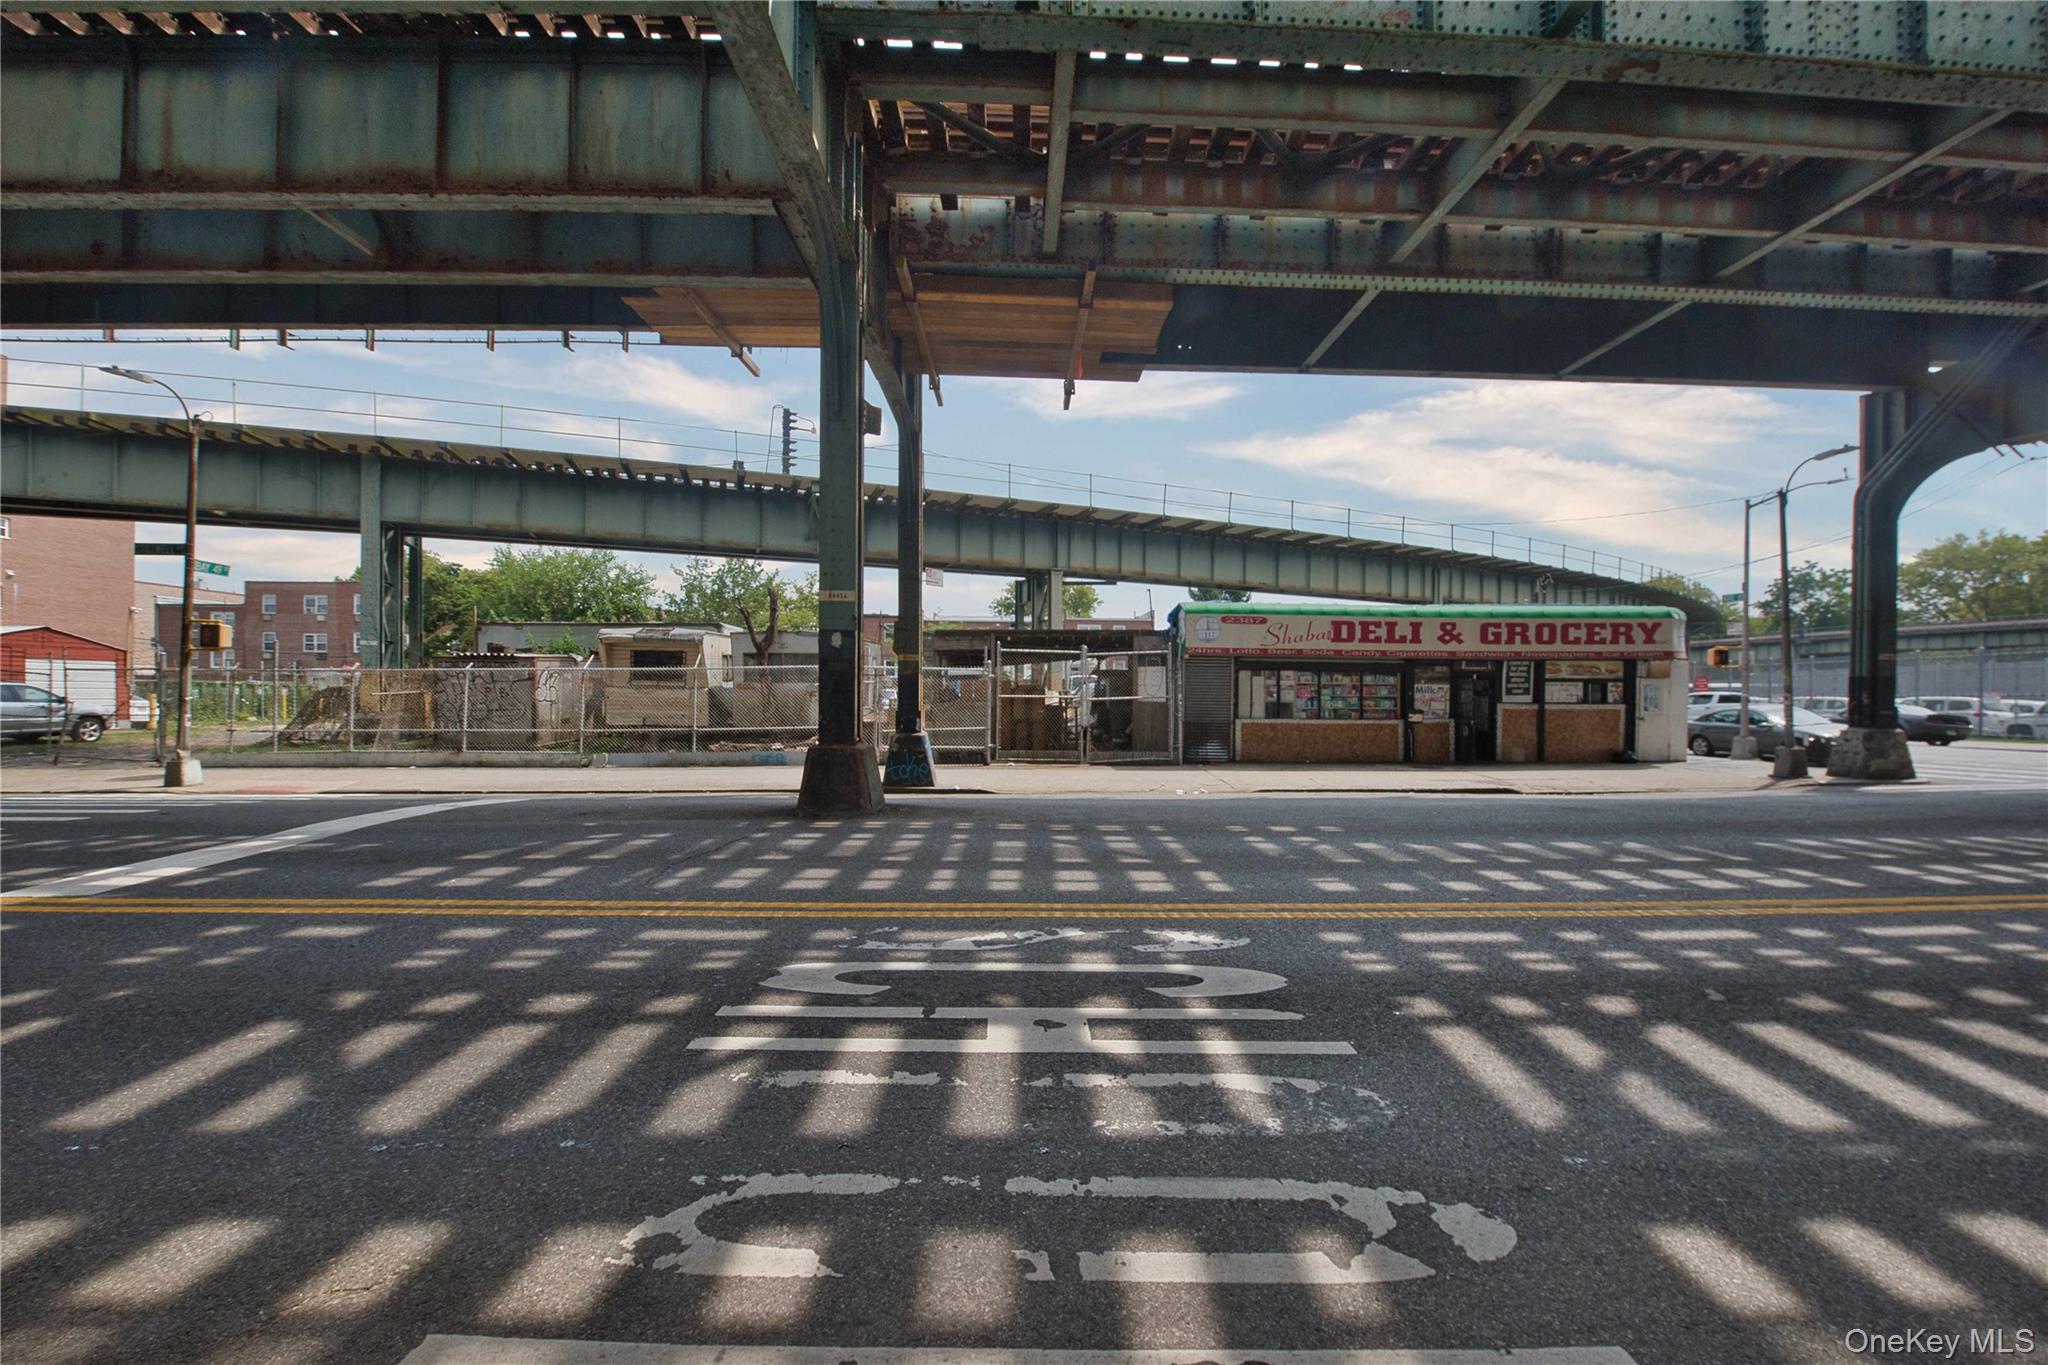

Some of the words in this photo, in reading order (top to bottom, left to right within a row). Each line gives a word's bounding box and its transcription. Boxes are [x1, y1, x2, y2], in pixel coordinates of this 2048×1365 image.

[1331, 620, 1423, 644] DELI
[1436, 621, 1465, 645] &
[1480, 622, 1662, 645] GROCERY
